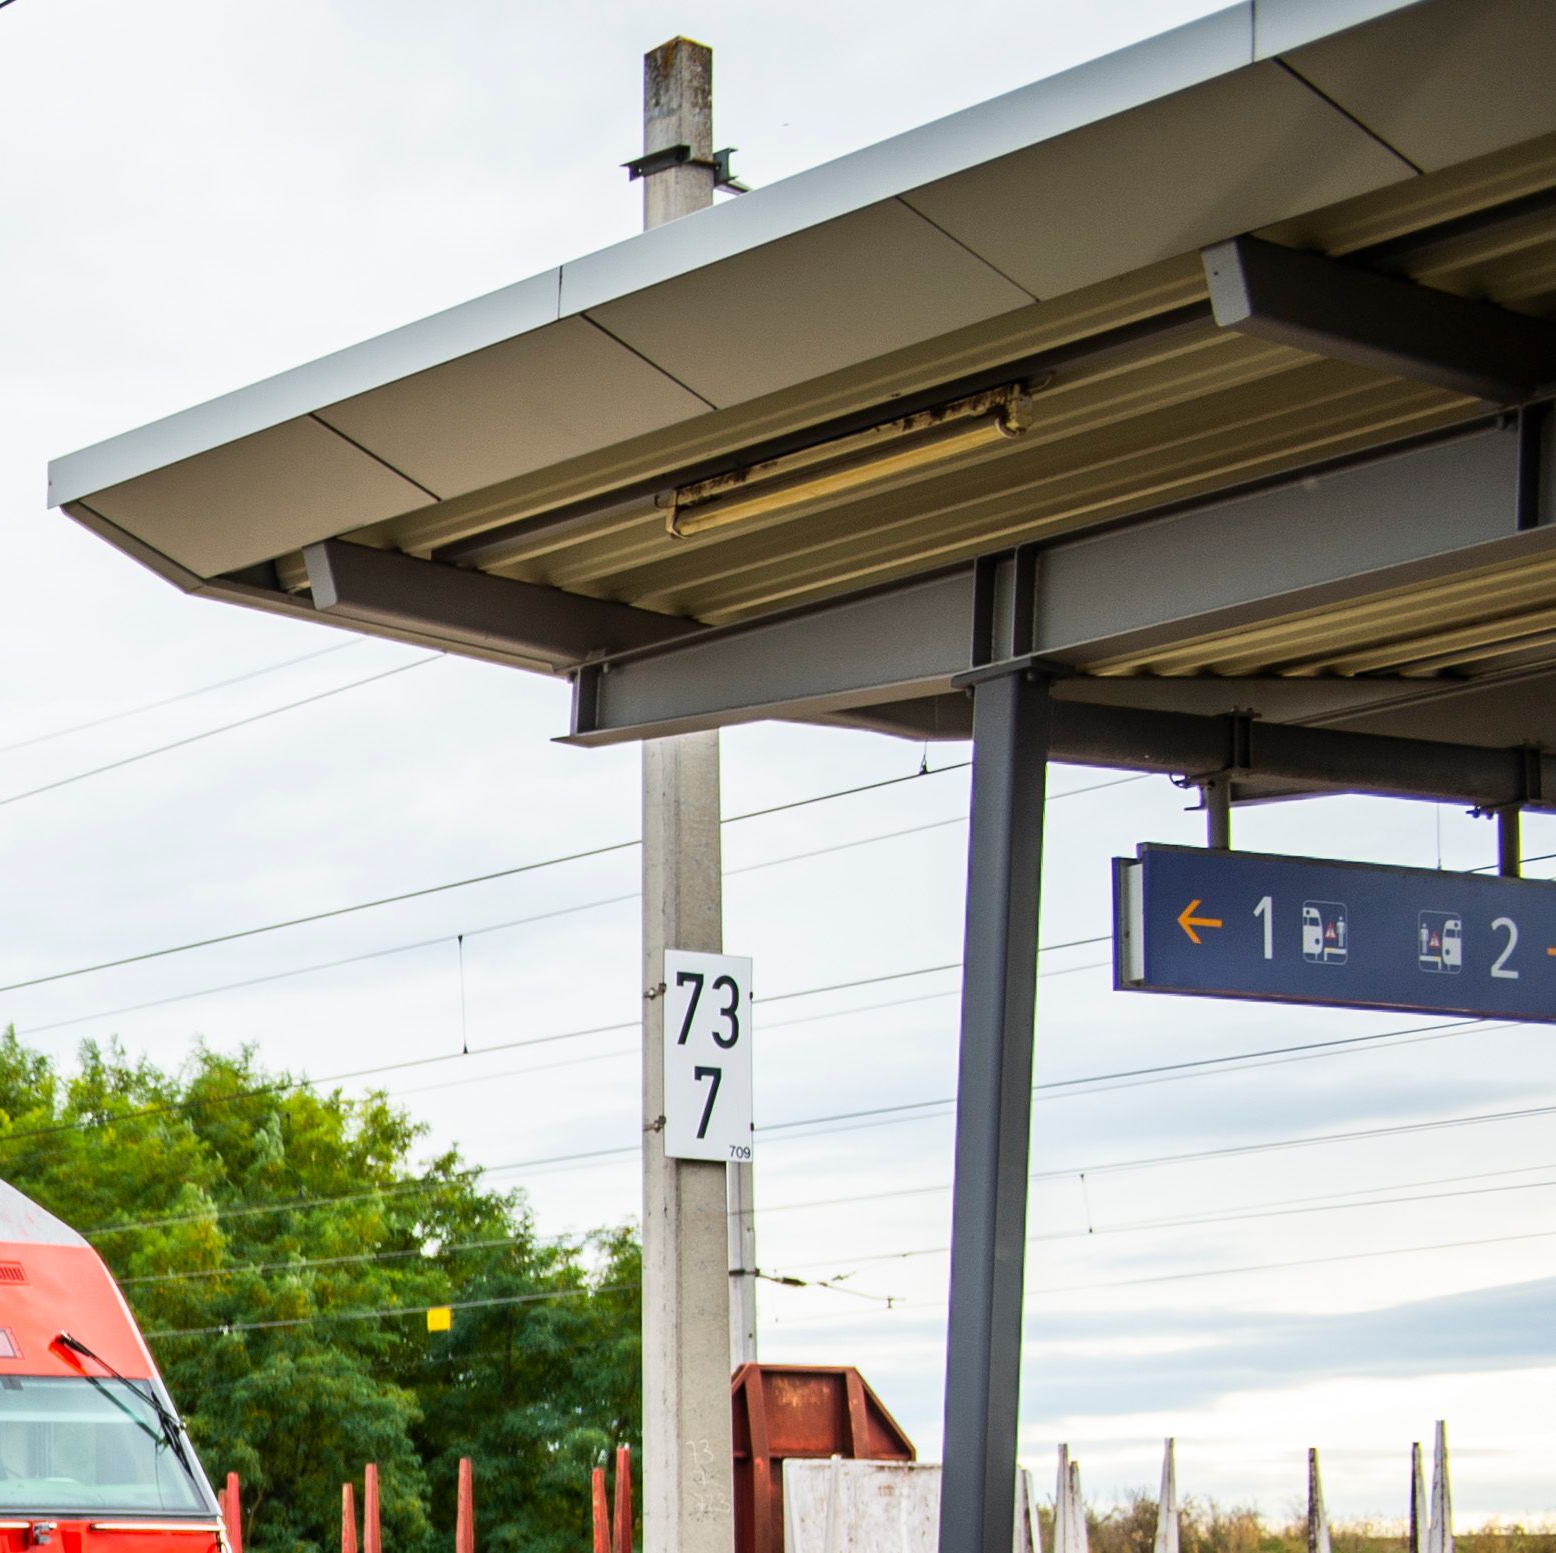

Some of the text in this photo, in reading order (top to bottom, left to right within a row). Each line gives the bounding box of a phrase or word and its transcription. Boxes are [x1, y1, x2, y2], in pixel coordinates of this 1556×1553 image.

[1253, 896, 1519, 979] 1 2
[676, 971, 740, 1049] 73
[694, 1066, 722, 1139] 7
[729, 1145, 751, 1159] 709
